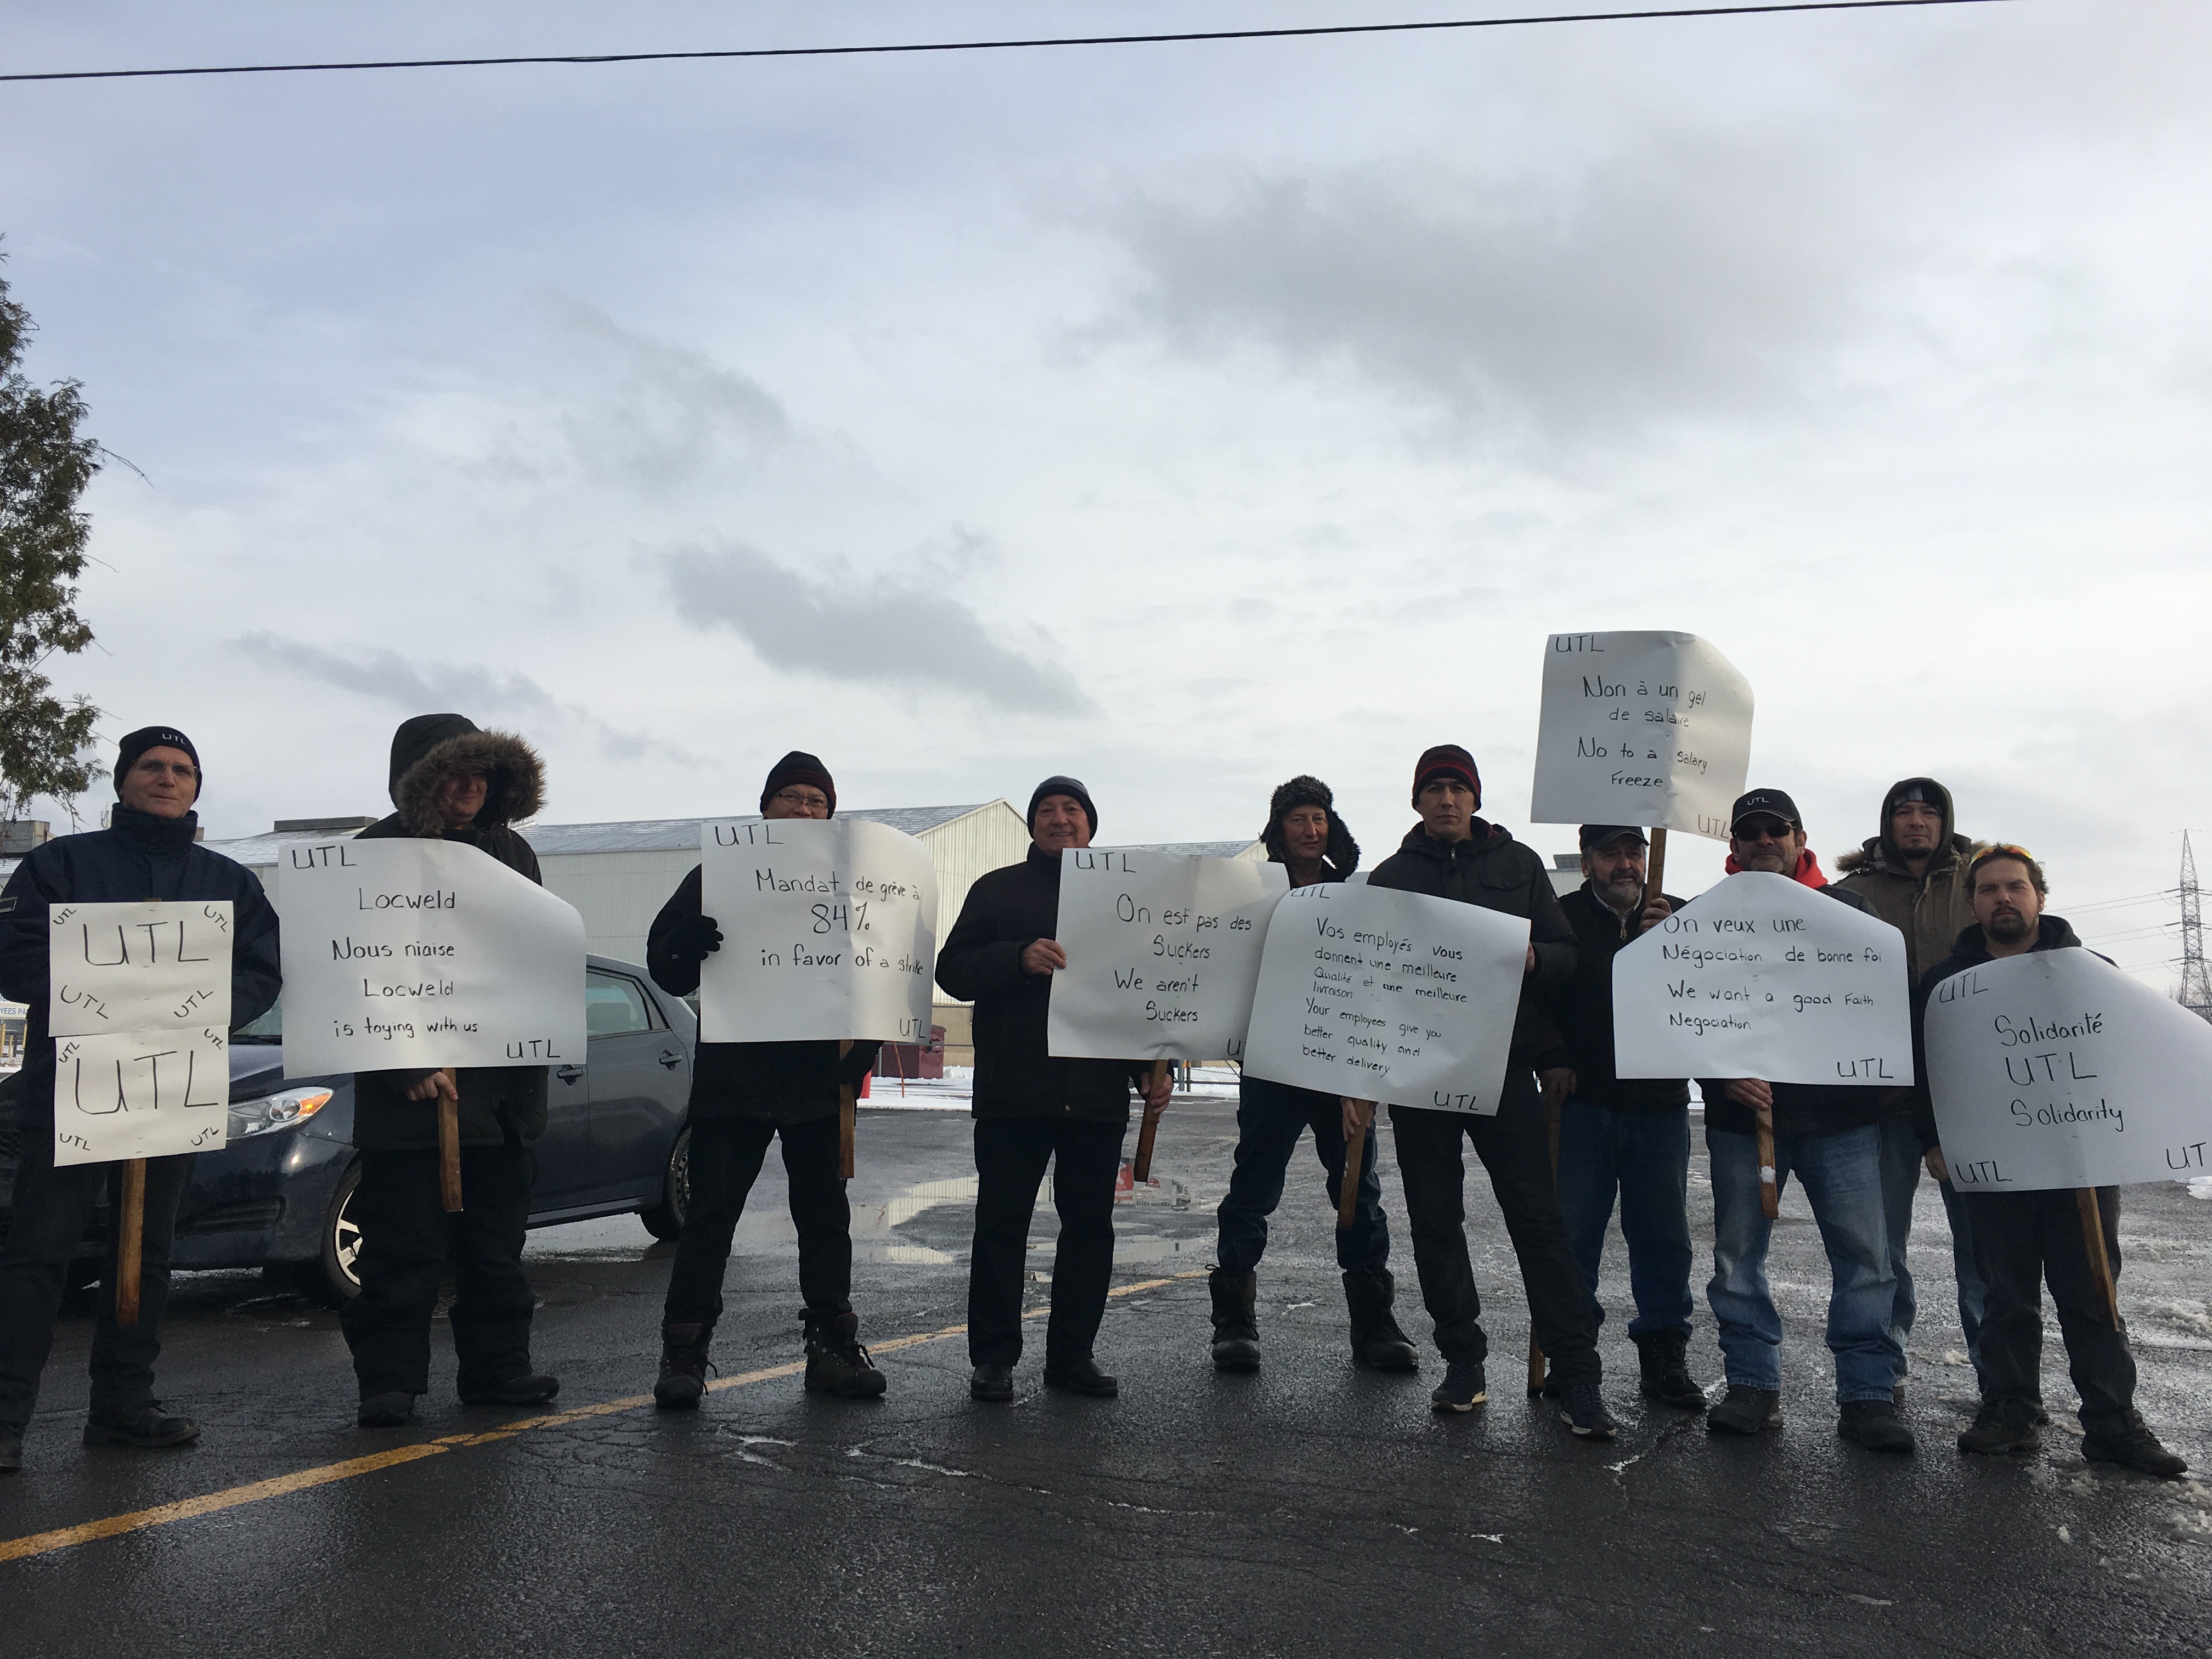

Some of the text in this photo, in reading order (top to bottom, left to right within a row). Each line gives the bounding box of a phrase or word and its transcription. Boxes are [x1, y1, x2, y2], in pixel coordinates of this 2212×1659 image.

[1555, 634, 1604, 652] UTL
[1583, 675, 1706, 709] Non à un gel
[1609, 707, 1689, 727] de salaire
[162, 733, 186, 745] UTL
[1578, 737, 1707, 775] No to a salary
[1612, 770, 1663, 787] Freeze
[1747, 797, 1769, 806] UTL
[715, 824, 783, 846] UTL
[1699, 815, 1729, 839] UTL
[292, 846, 357, 869] UTL
[1076, 851, 1136, 873] UTL
[756, 868, 839, 892] Mandat
[856, 876, 873, 893] de
[912, 885, 919, 900] à
[1291, 885, 1329, 899] UTL
[359, 888, 455, 910] Locweld
[53, 909, 76, 924] UTL
[204, 905, 227, 932] UTL
[811, 901, 870, 933] 84%
[1117, 894, 1251, 933] On est pas des
[1664, 916, 1805, 933] On veux une
[83, 921, 209, 966] UTL
[332, 937, 454, 960] Nous niaise
[1154, 935, 1209, 958] Suckers
[1317, 917, 1462, 960] Vos employés vous
[761, 944, 923, 975] in favor of a strike
[1314, 946, 1456, 981] donnent une meilleure
[1663, 944, 1881, 968] Négociation de bonne foi
[364, 979, 453, 996] Locweld
[1115, 968, 1198, 992] We aren't
[1313, 981, 1352, 998] livraison
[1363, 975, 1374, 986] et
[1383, 984, 1402, 992] une
[1416, 987, 1466, 1002] meilleure
[1939, 972, 1989, 1003] UTL
[60, 985, 108, 1019] UTL
[174, 991, 213, 1017] UTL
[1667, 980, 1873, 1012] We want a good Faith
[1146, 1001, 1198, 1022] Suckers
[1306, 997, 1330, 1015] Your
[1340, 1012, 1386, 1029] employees
[1400, 1024, 1418, 1036] give
[334, 1017, 477, 1040] is toying with us
[900, 1019, 926, 1038] UTL
[1670, 1012, 1751, 1035] Negociation
[1995, 1013, 2102, 1046] Solidarité
[205, 1029, 223, 1050] UTL
[507, 1040, 560, 1058] UTL
[1305, 1024, 1419, 1057] better quality and
[59, 1042, 80, 1064] UTL
[1303, 1044, 1390, 1077] better delivery
[1837, 1058, 1894, 1079] UTL
[2006, 1052, 2097, 1086] UTL
[75, 1051, 218, 1115] UTL
[1435, 1091, 1479, 1110] UTL
[2011, 1099, 2123, 1132] Solidarity
[60, 1133, 90, 1150] UTL
[191, 1127, 219, 1146] UTL
[2166, 1142, 2206, 1169] UT
[1955, 1161, 2012, 1183] UTL
